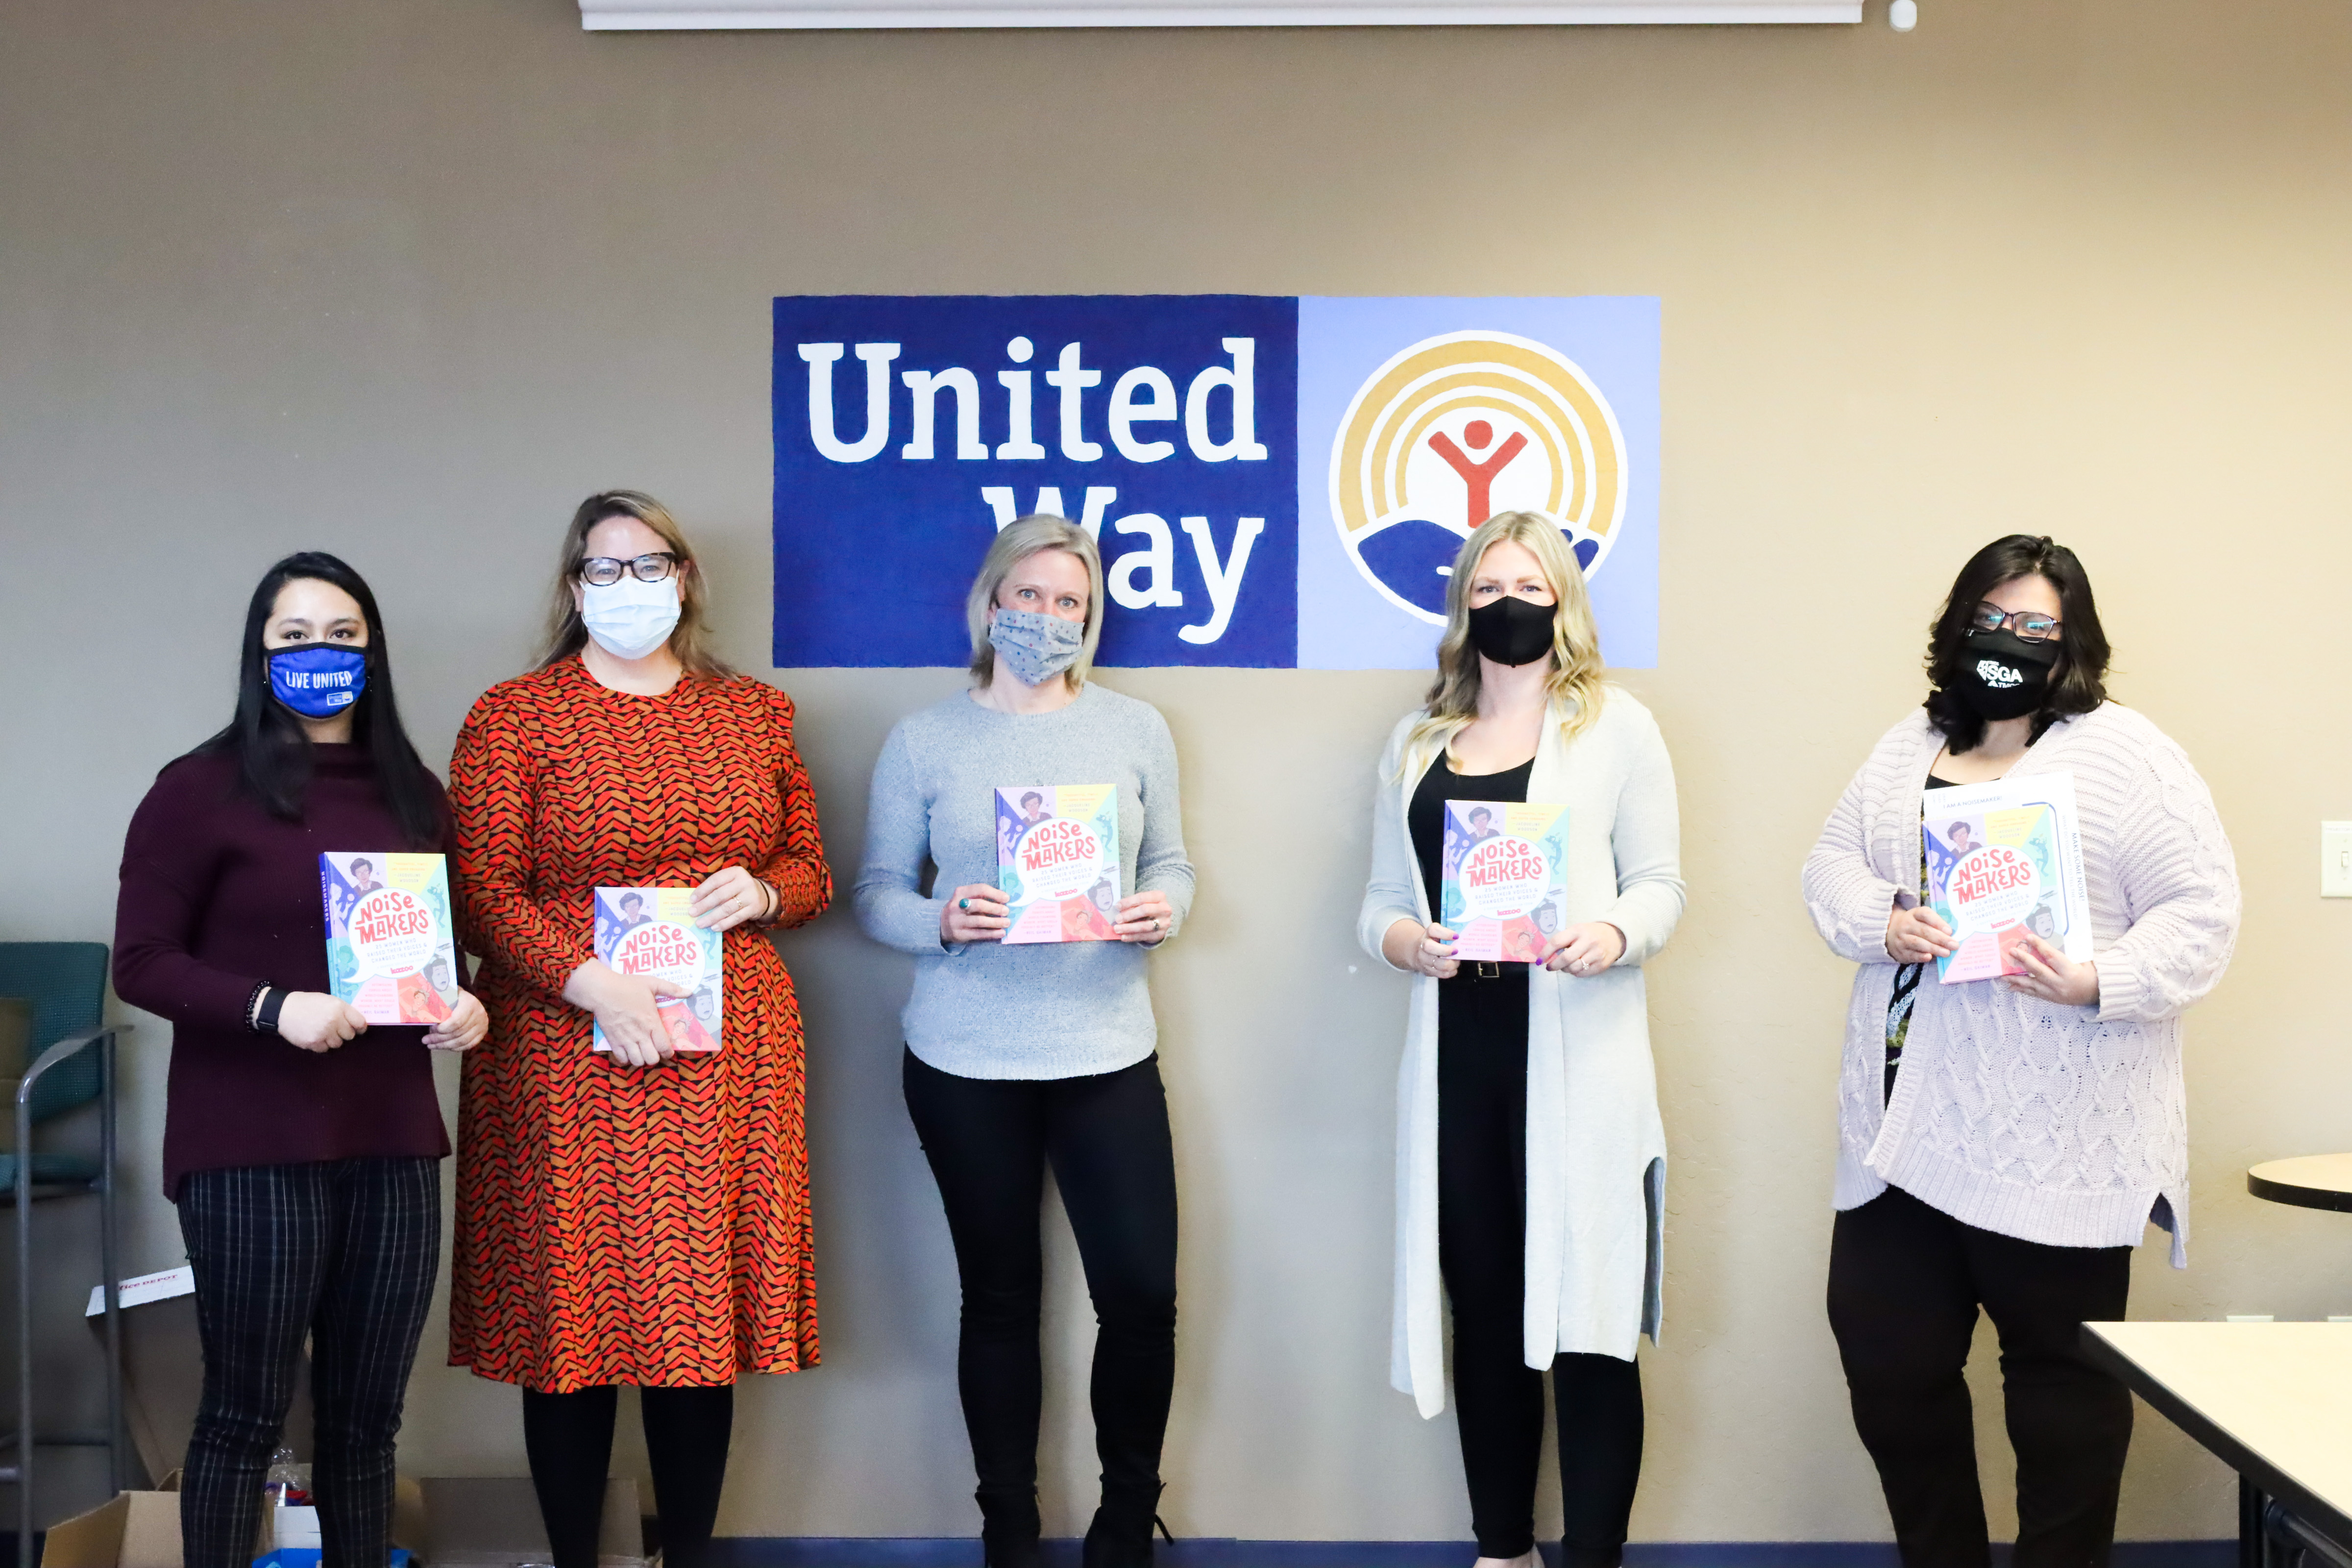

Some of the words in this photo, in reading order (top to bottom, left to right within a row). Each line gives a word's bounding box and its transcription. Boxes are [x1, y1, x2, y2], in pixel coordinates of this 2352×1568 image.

[798, 337, 1267, 463] United
[286, 671, 309, 688] LIVE
[313, 671, 352, 688] UNITED
[1987, 665, 2023, 683] SGA
[1962, 796, 2002, 806] NOISEMAKER!
[1022, 836, 1095, 871] MAKERS
[1466, 857, 1542, 887] MAKERS
[1953, 862, 2031, 905] MAKERS
[321, 871, 329, 922] NOISEMAKERS
[1966, 907, 1985, 916] RAISED
[2005, 896, 2024, 904] VOICES
[1984, 896, 2003, 904] WOMEN
[1971, 910, 1995, 921] CHANGED
[2010, 901, 2028, 909] WORLD
[355, 909, 429, 944] MAKERS
[618, 942, 696, 975] MAKERS
[143, 1274, 178, 1285] DEPOT
